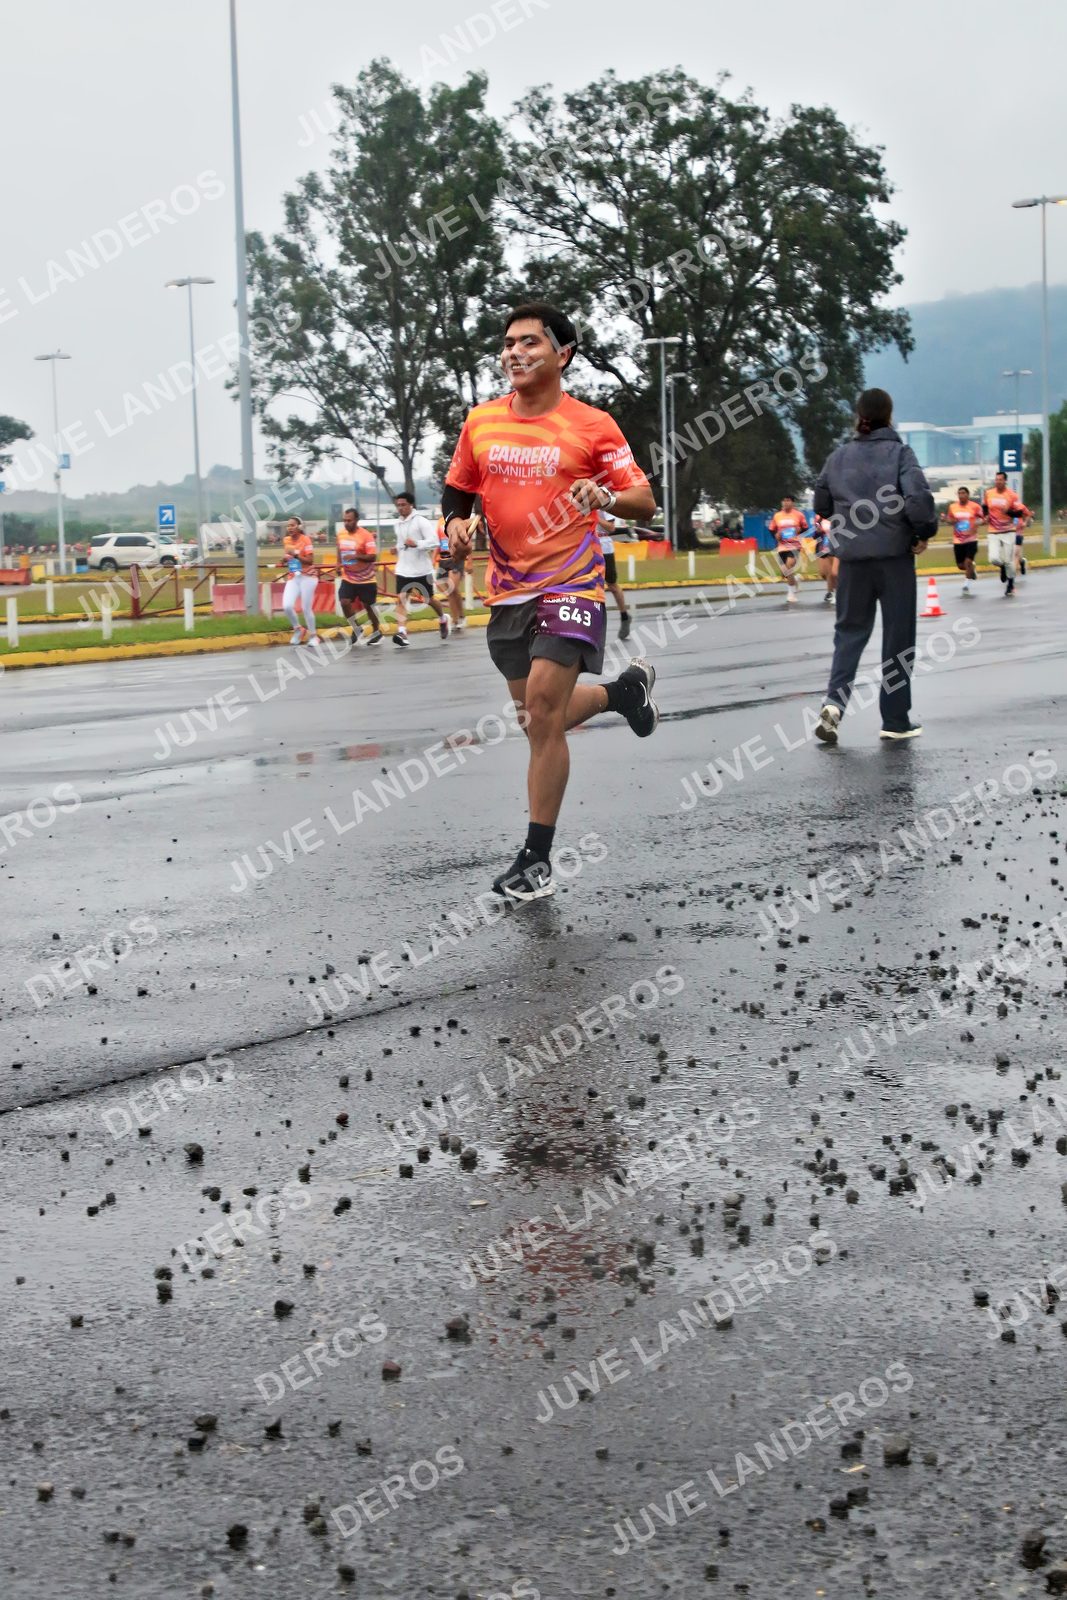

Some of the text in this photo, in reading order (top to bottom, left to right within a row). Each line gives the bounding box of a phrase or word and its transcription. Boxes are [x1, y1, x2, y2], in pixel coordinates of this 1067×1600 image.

[488, 445, 560, 465] CARRERA
[1003, 449, 1017, 467] E
[488, 463, 541, 478] OMNILIFE
[559, 605, 591, 627] 643
